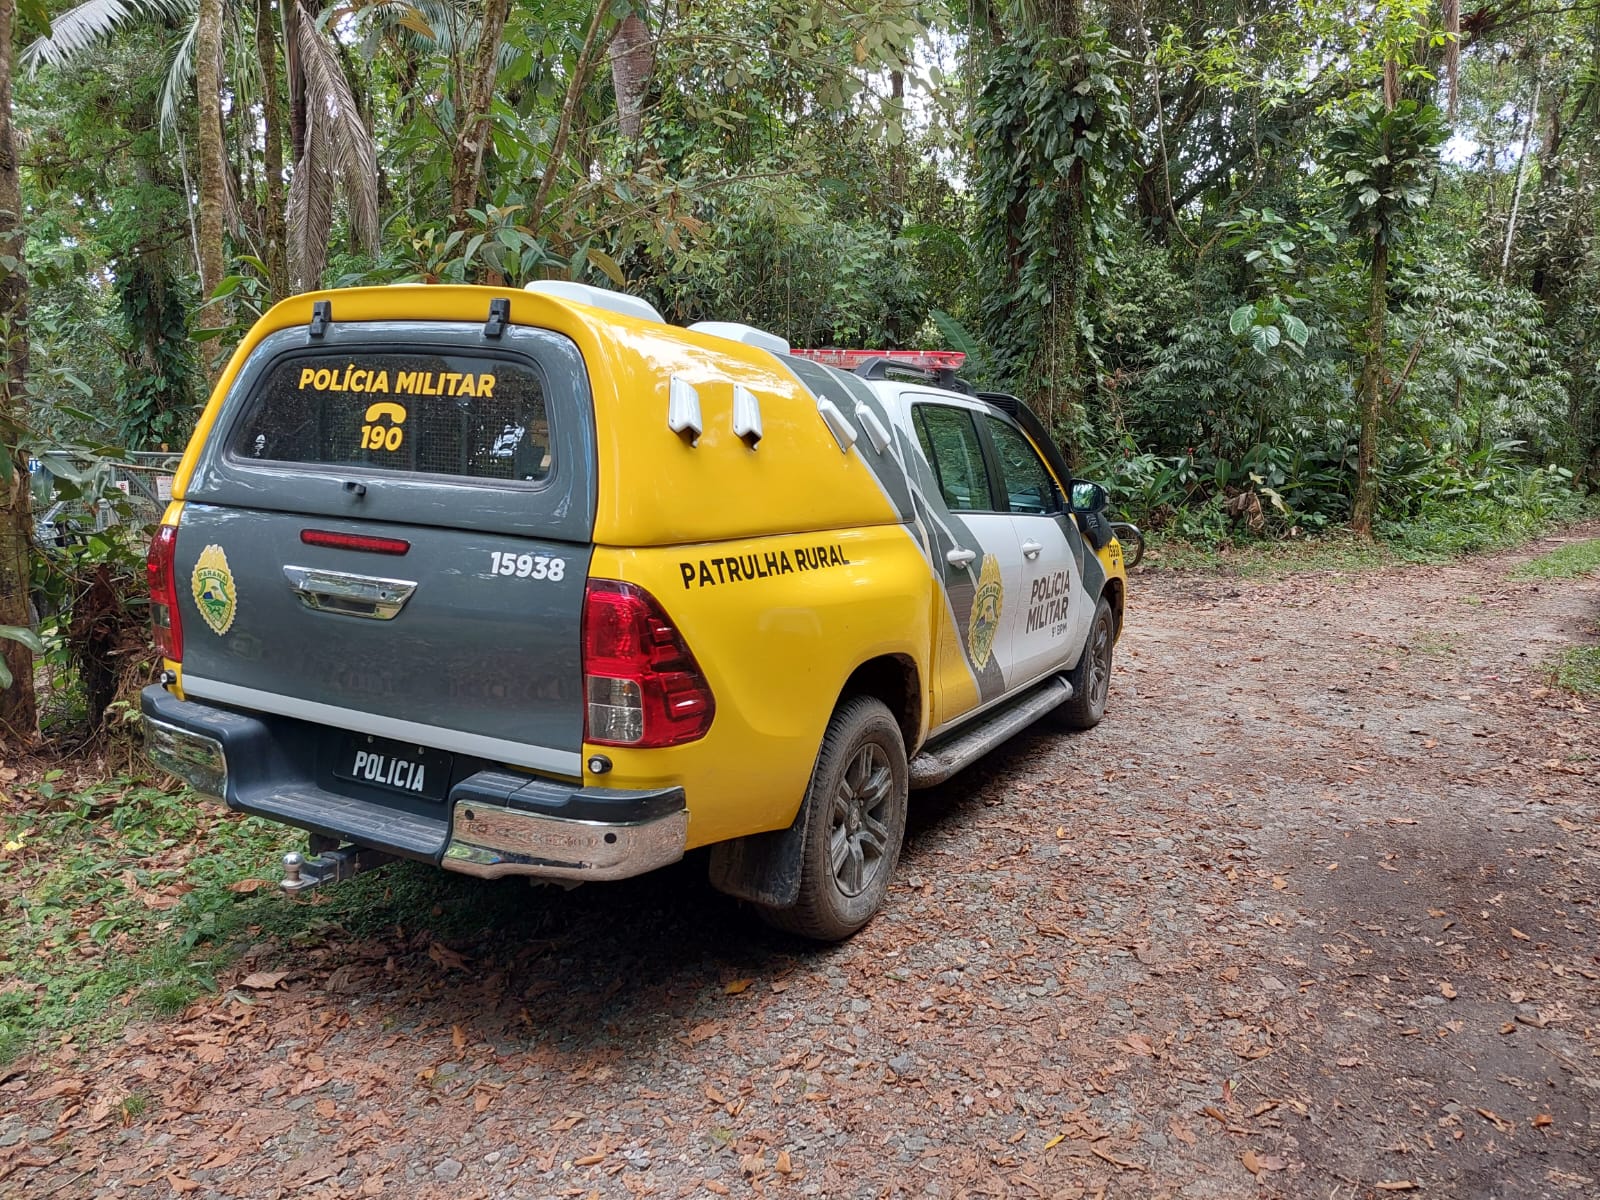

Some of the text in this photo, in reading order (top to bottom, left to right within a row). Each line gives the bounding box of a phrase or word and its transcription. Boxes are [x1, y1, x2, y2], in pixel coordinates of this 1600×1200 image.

[298, 364, 496, 398] POLÍCIA MILITAR
[360, 425, 403, 451] 190
[491, 552, 566, 582] 15938
[679, 544, 850, 590] PATRULHA RURAL
[1030, 570, 1070, 605] POLÍCIA
[1025, 596, 1069, 634] MILITAR
[352, 751, 425, 792] POLÍCIA
